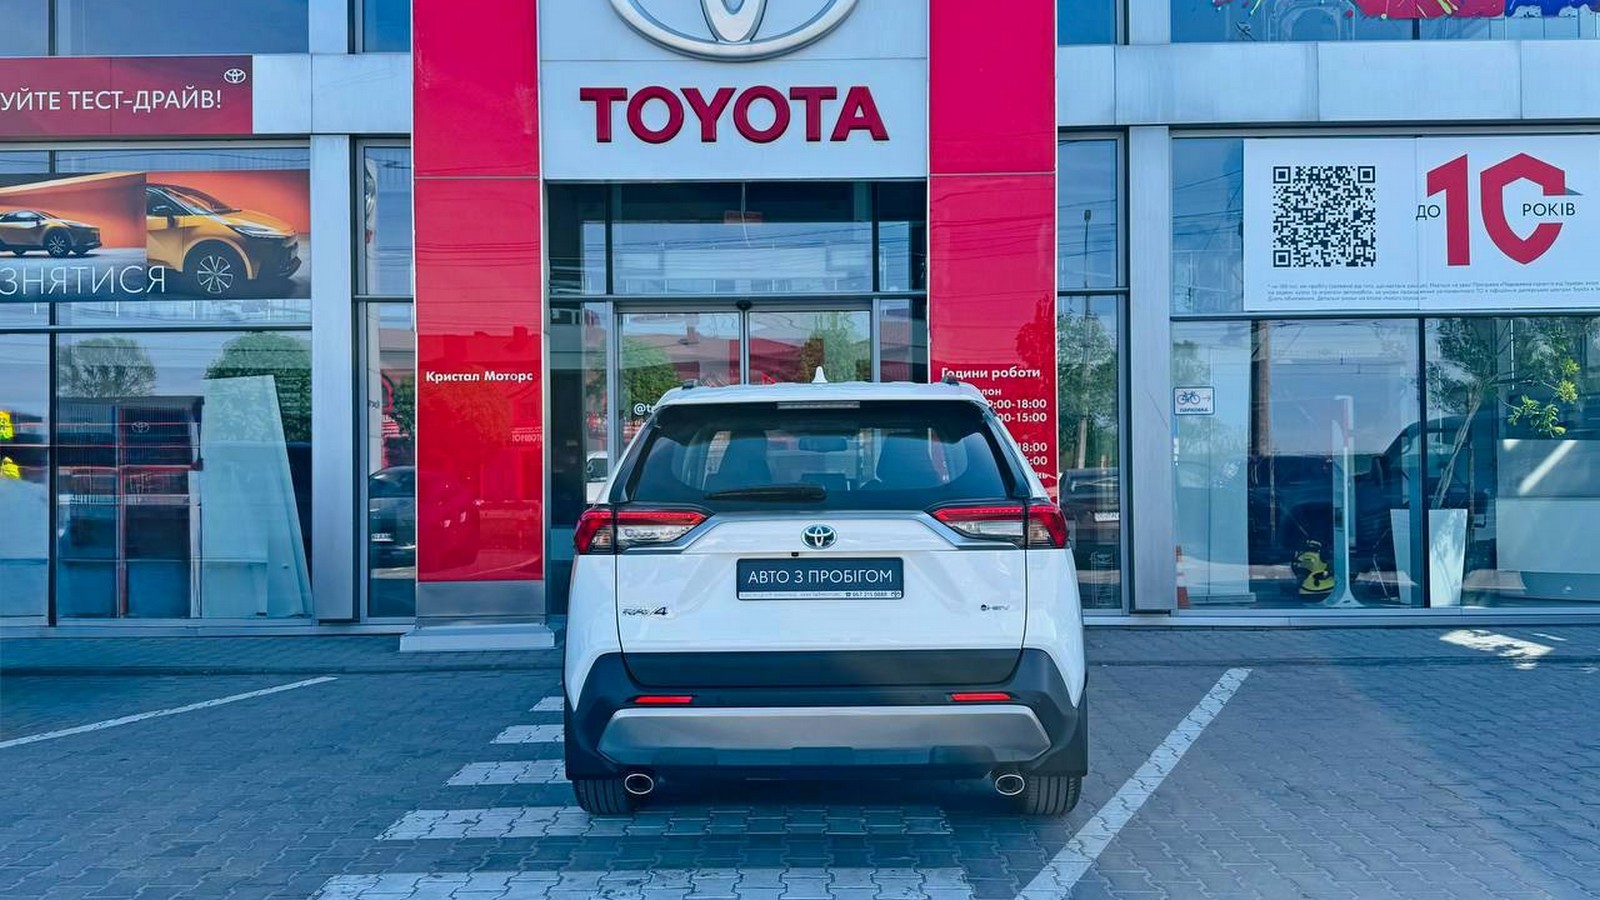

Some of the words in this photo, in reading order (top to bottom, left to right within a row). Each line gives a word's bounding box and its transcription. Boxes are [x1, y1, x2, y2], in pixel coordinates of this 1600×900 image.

[0, 87, 61, 111] УЙТЕ
[68, 85, 221, 113] ТЕСТ-ДРАЙВ!
[579, 85, 890, 143] TOYOTA
[1415, 204, 1441, 221] ДО
[1522, 202, 1576, 217] РОКІВ
[0, 265, 165, 296] ЗНЯТИСЯ
[426, 371, 480, 384] Кристал
[484, 370, 533, 383] Моторс
[991, 366, 1041, 381] роботи
[981, 388, 1002, 396] лон
[748, 569, 790, 584] АВТО
[808, 568, 893, 584] ПРОБІГОМ
